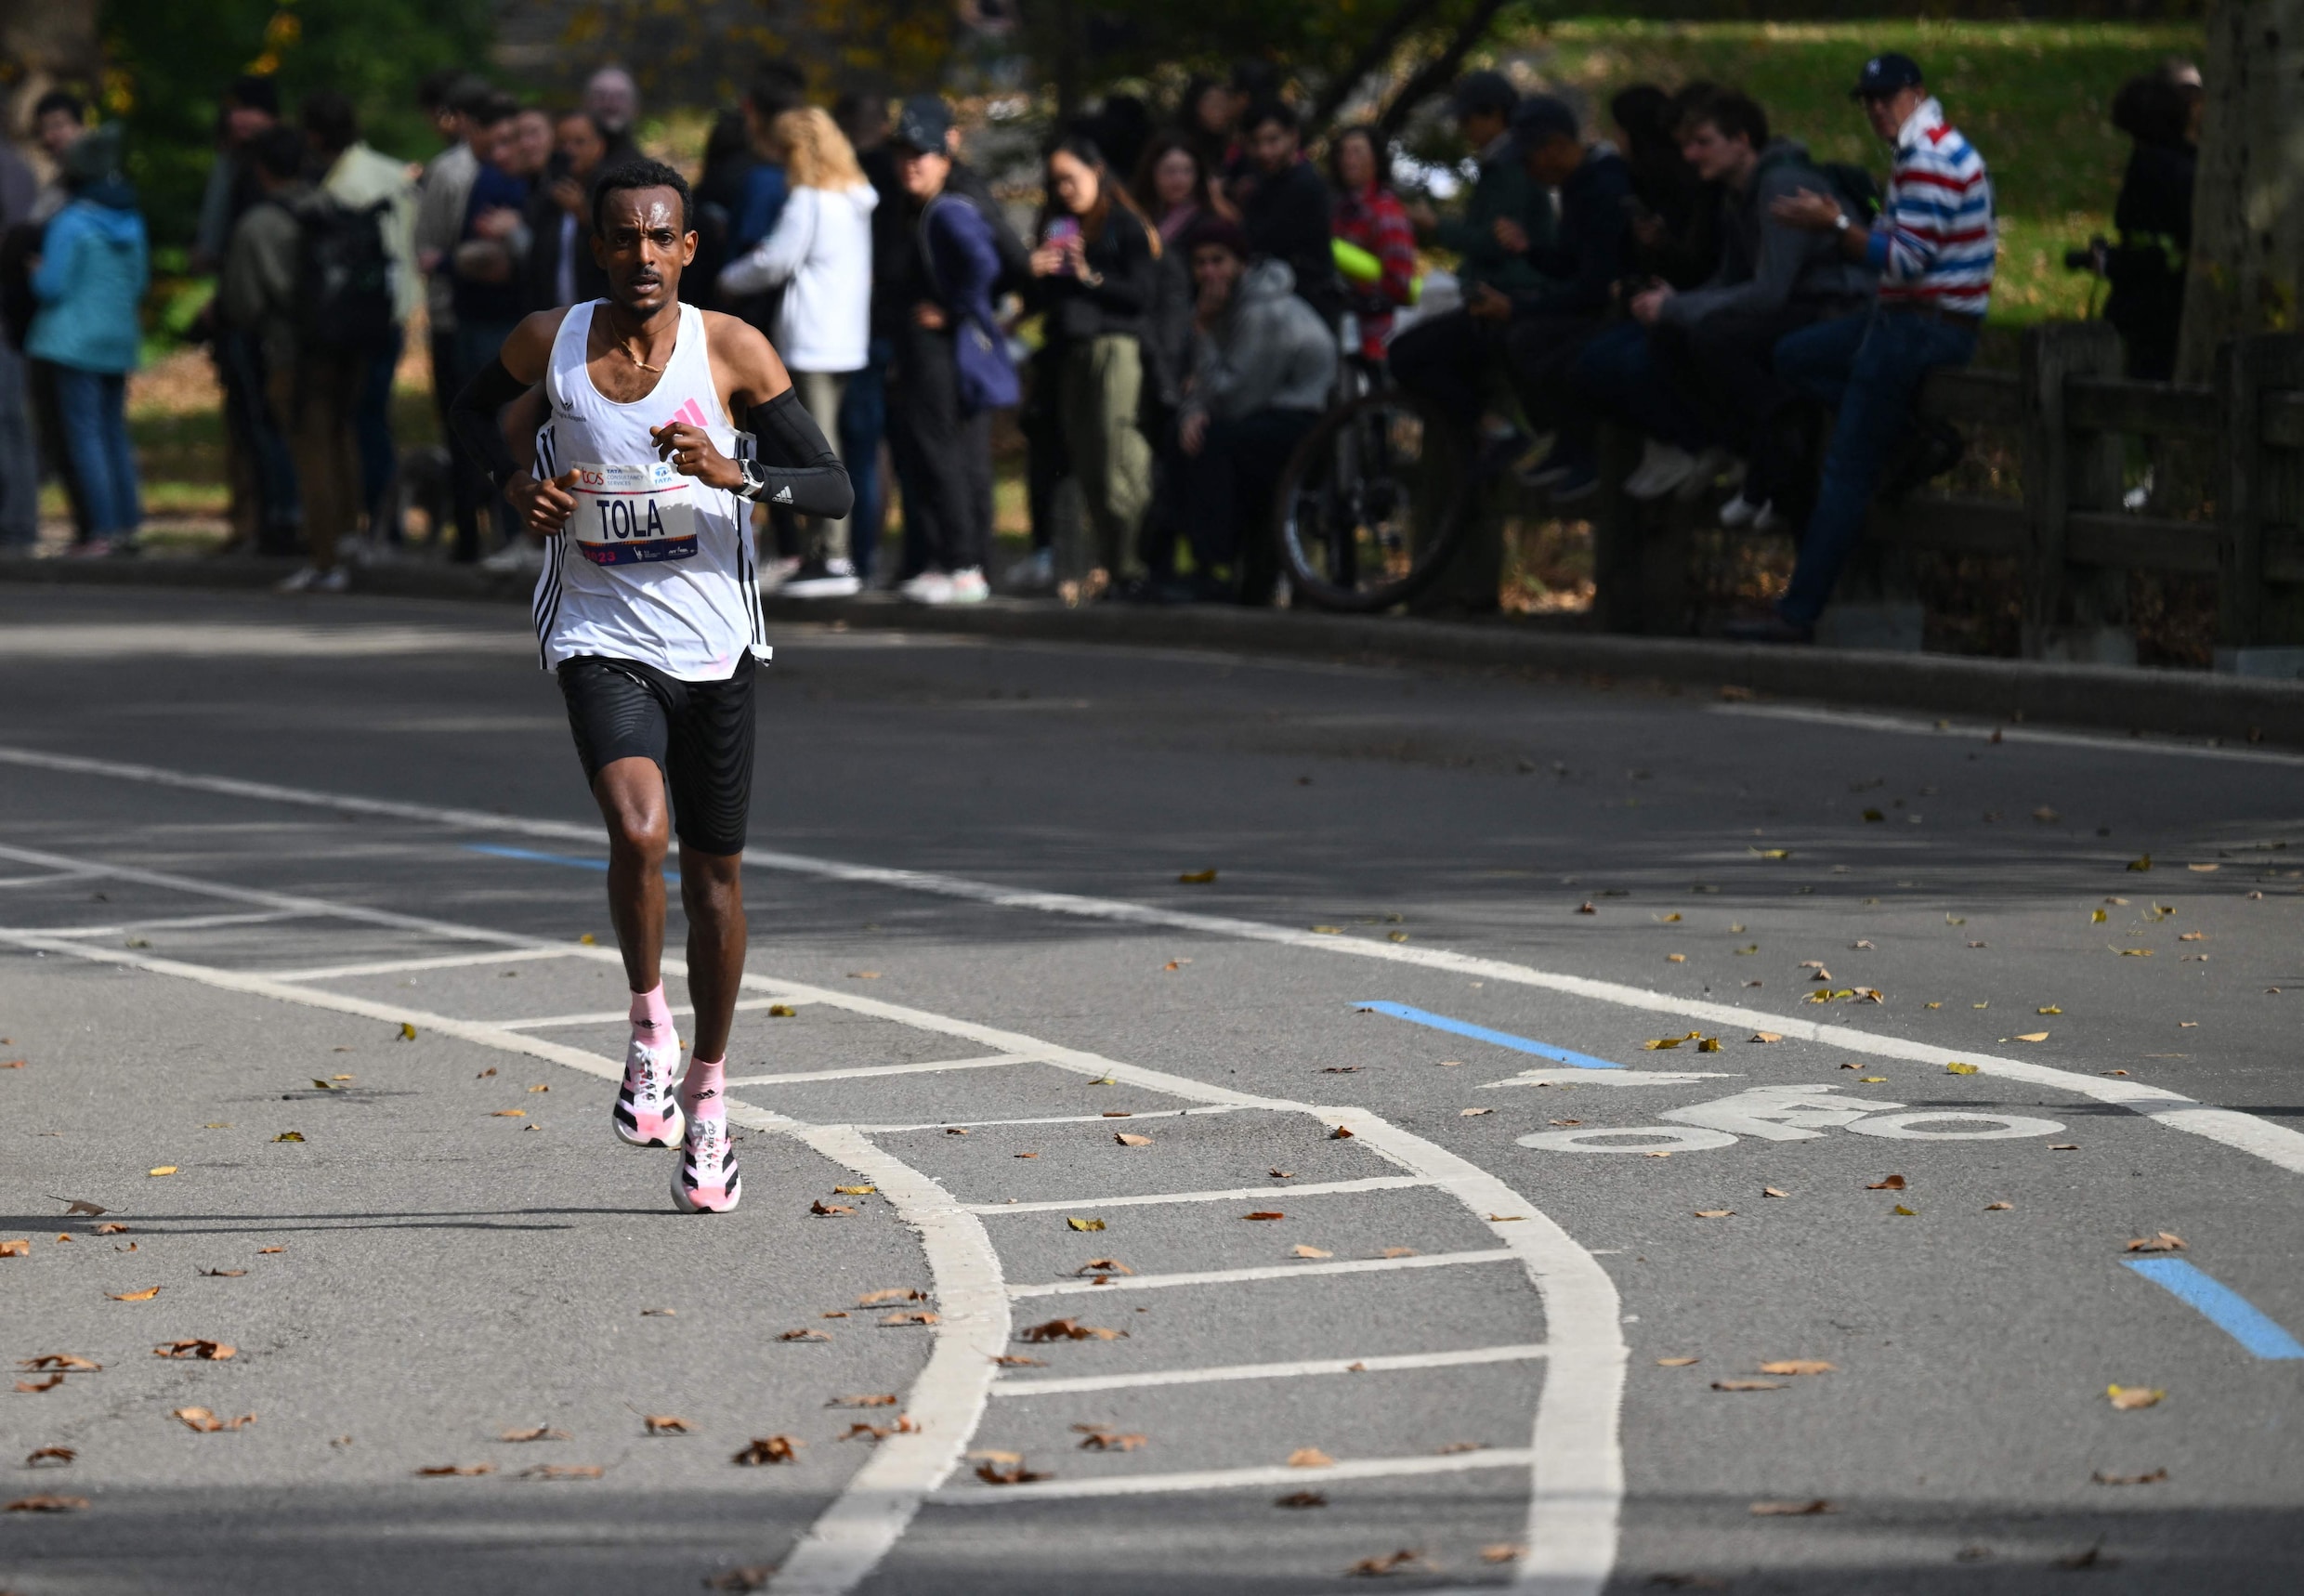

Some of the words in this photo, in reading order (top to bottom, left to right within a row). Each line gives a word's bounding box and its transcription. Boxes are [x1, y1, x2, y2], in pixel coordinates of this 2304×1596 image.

[582, 467, 604, 485] tcs
[771, 496, 794, 504] adidas
[596, 499, 665, 540] TOLA
